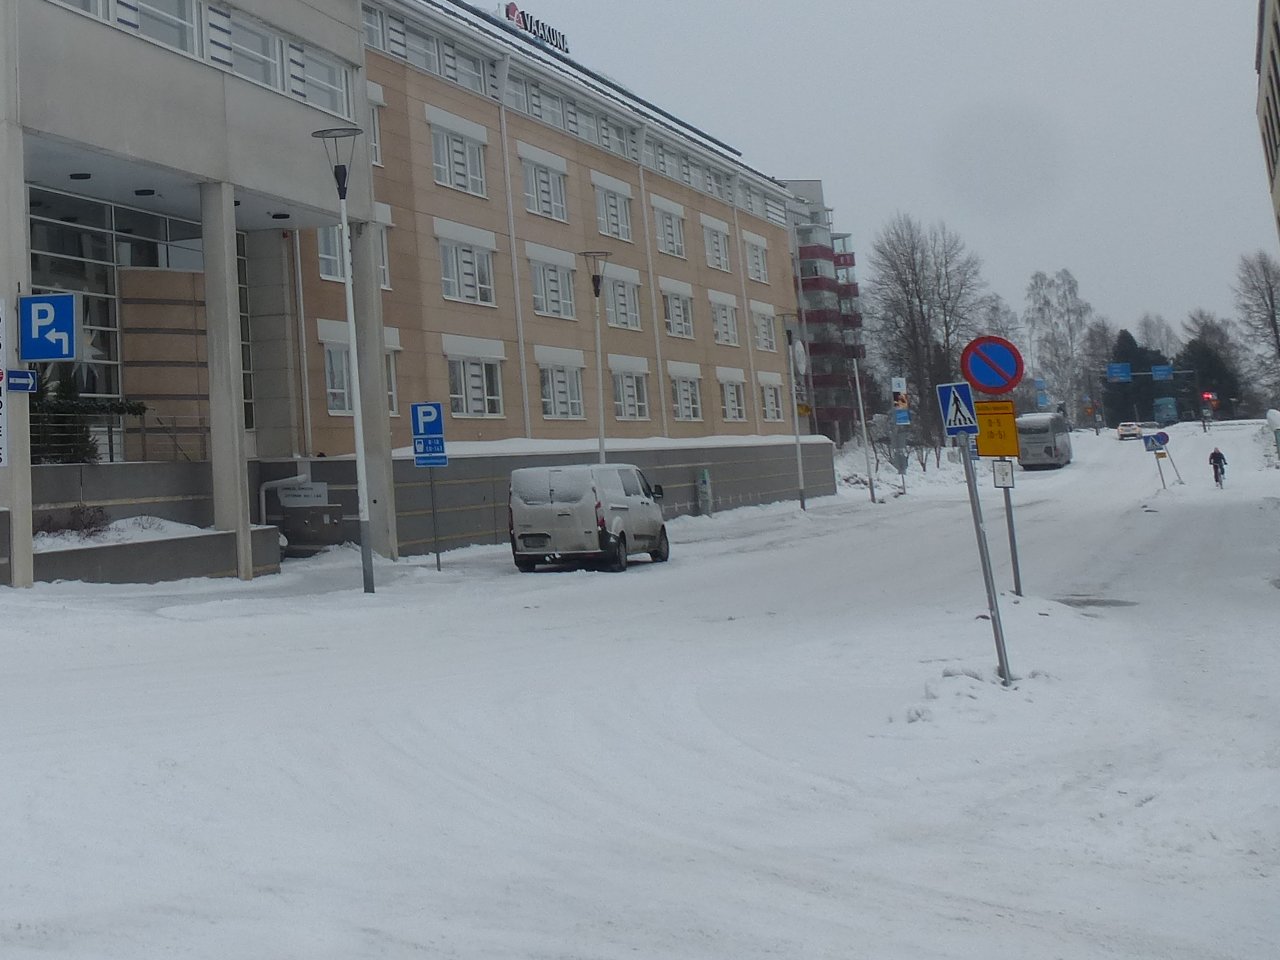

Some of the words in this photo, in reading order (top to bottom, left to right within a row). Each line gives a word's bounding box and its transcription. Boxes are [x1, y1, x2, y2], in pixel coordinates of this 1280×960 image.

[519, 11, 570, 54] VAAKUNA
[31, 302, 56, 339] P
[417, 405, 438, 434] P
